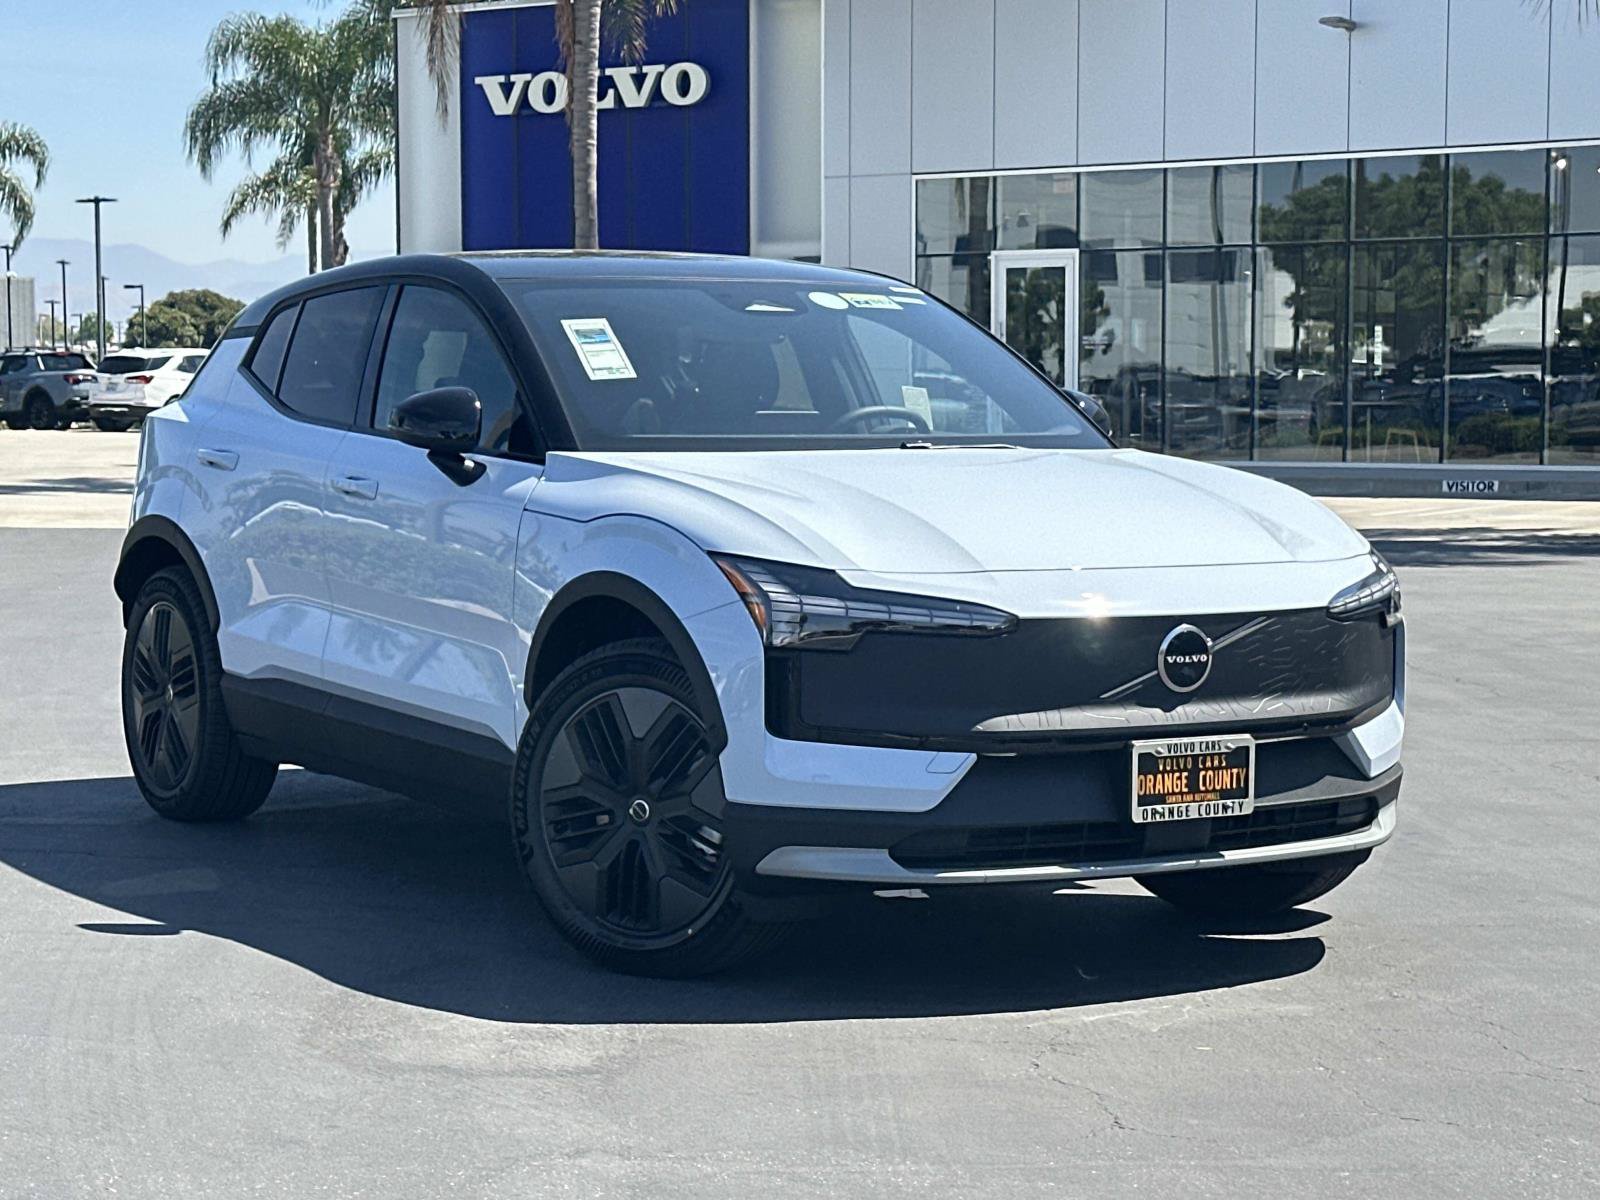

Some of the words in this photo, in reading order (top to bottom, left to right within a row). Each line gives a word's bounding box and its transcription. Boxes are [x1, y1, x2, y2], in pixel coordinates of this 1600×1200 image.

[1446, 481, 1495, 492] VISITOR
[1166, 654, 1208, 664] VOLVO
[1167, 743, 1195, 754] VOLVO
[1200, 741, 1222, 752] CARS
[1158, 757, 1192, 771] VOLVO
[1198, 755, 1226, 768] CARS
[1137, 771, 1189, 796] ORANGE
[1199, 768, 1247, 791] COUNTY
[1142, 804, 1191, 821] ORANGE
[1198, 801, 1245, 817] COUNTY
